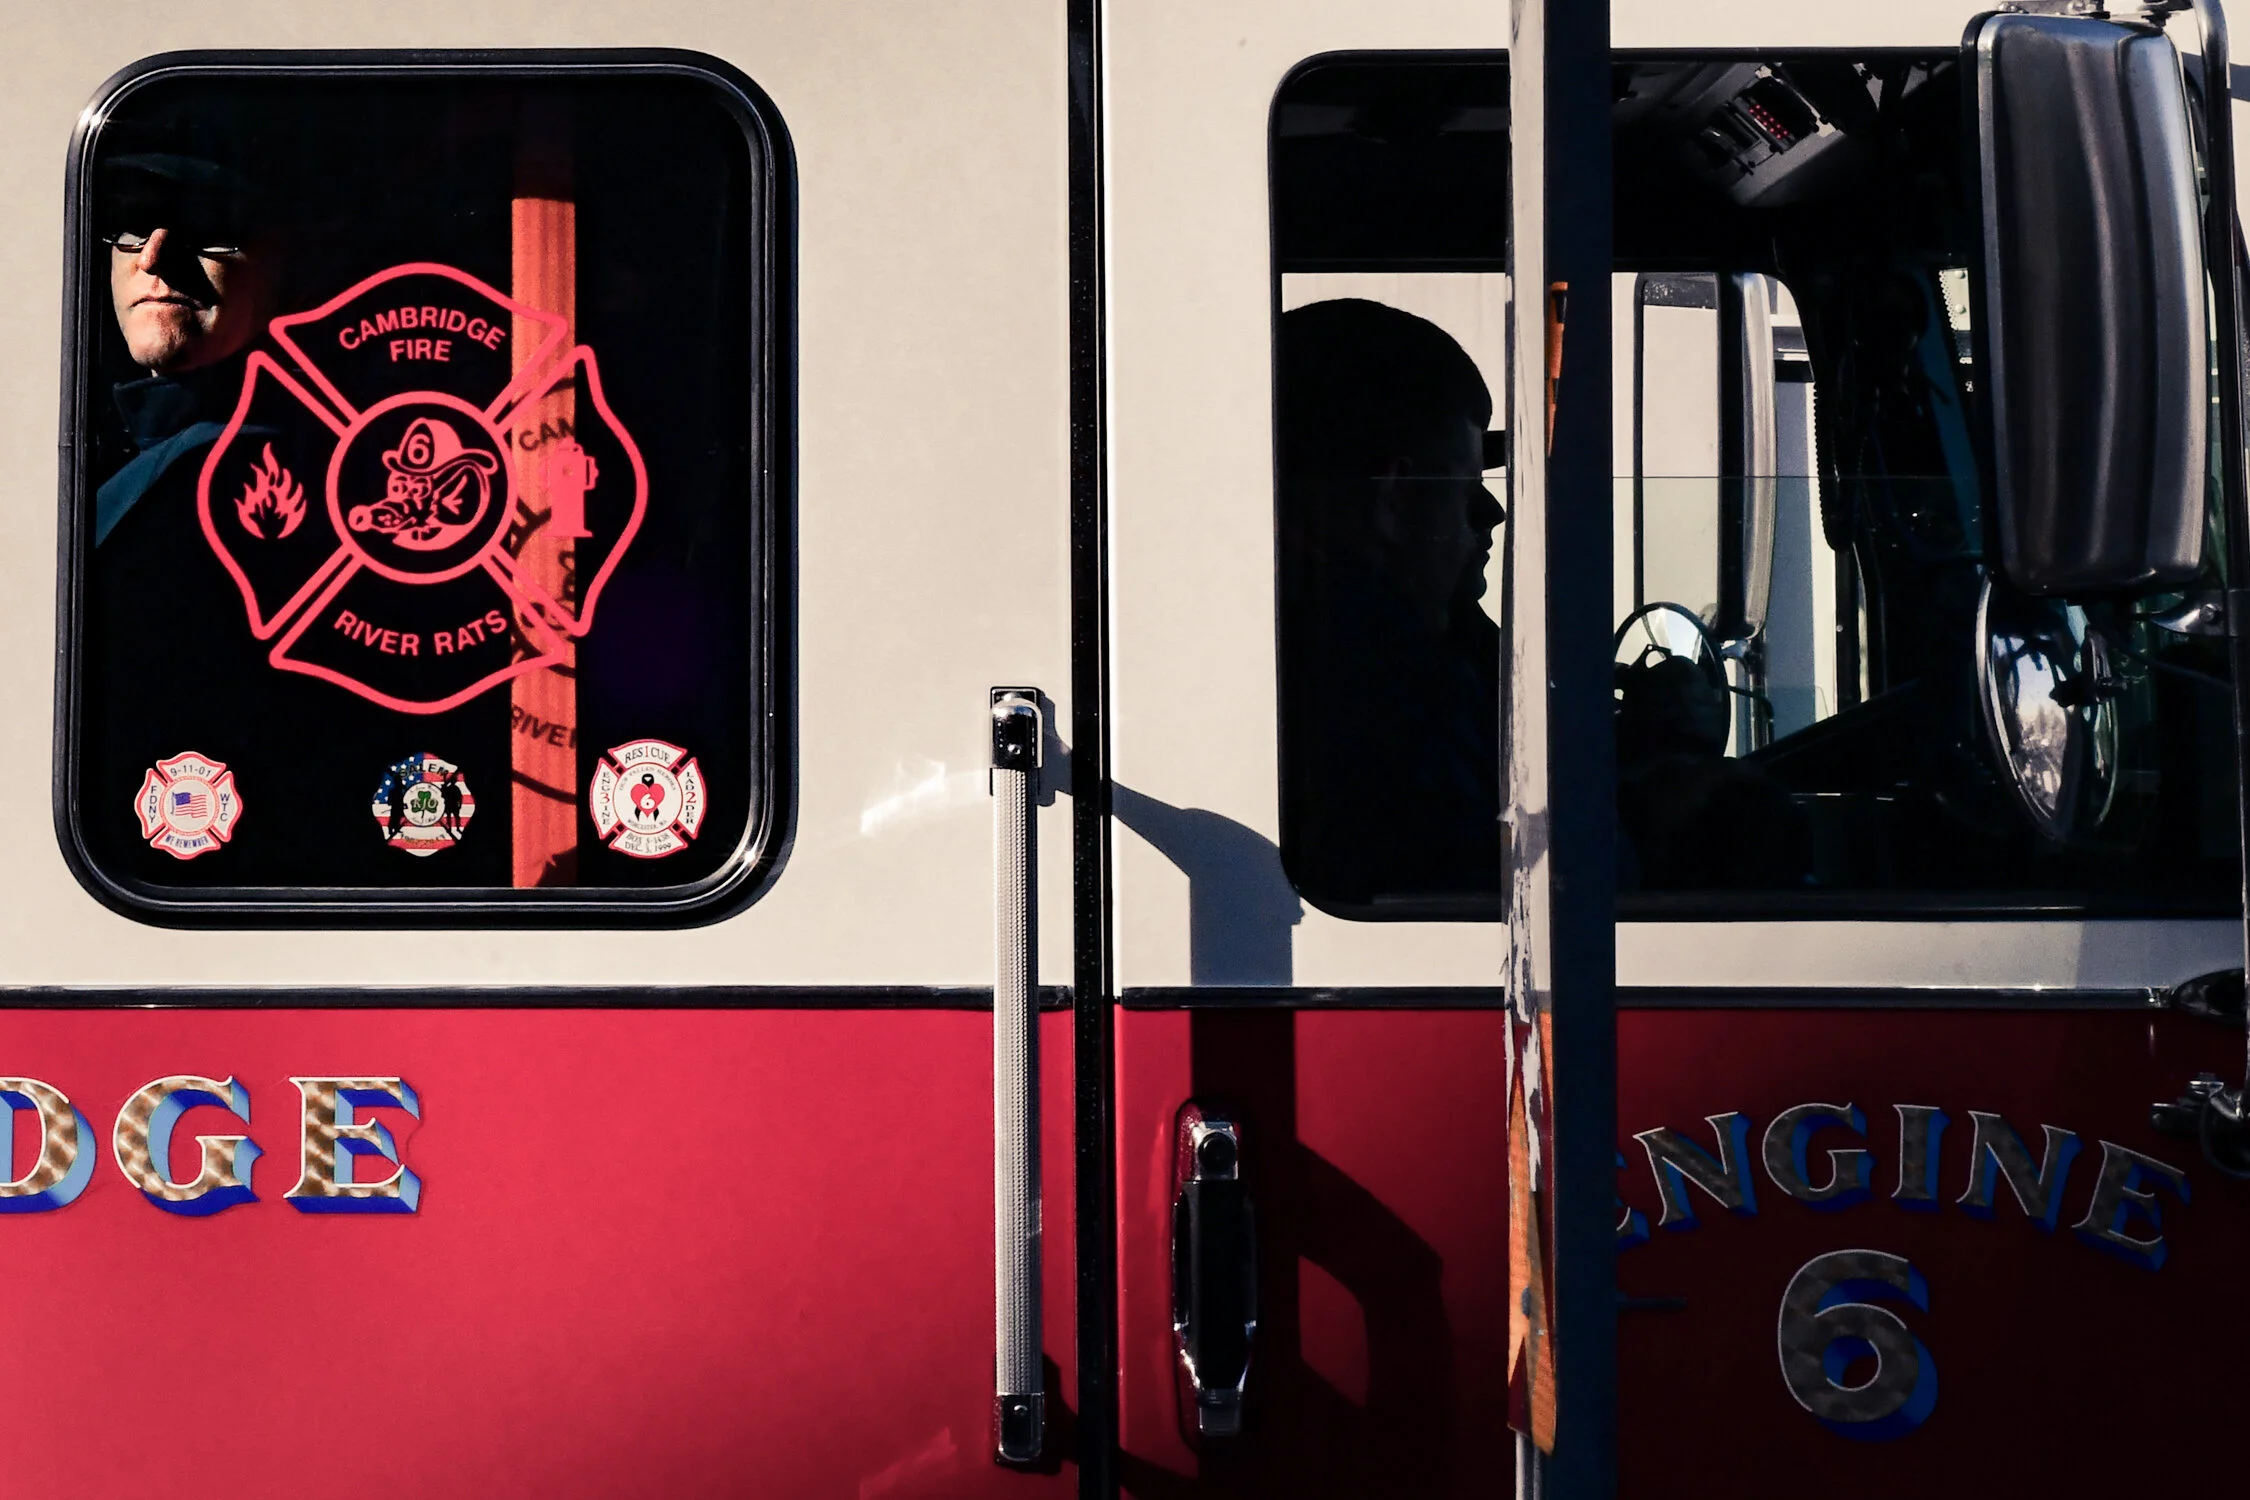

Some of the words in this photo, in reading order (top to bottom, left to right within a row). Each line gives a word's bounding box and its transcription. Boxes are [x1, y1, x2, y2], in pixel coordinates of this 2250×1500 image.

[338, 306, 506, 350] CAMBRIDGE
[389, 338, 452, 362] FIRE
[407, 433, 430, 465] 6
[333, 609, 420, 656] RIVER
[433, 610, 507, 656] RATS
[170, 764, 212, 777] 9-11-01
[149, 785, 158, 823] FDNY
[220, 793, 230, 822] WTC
[640, 793, 656, 809] 6
[0, 1075, 421, 1216] DGE
[1777, 1249, 1939, 1440] 6
